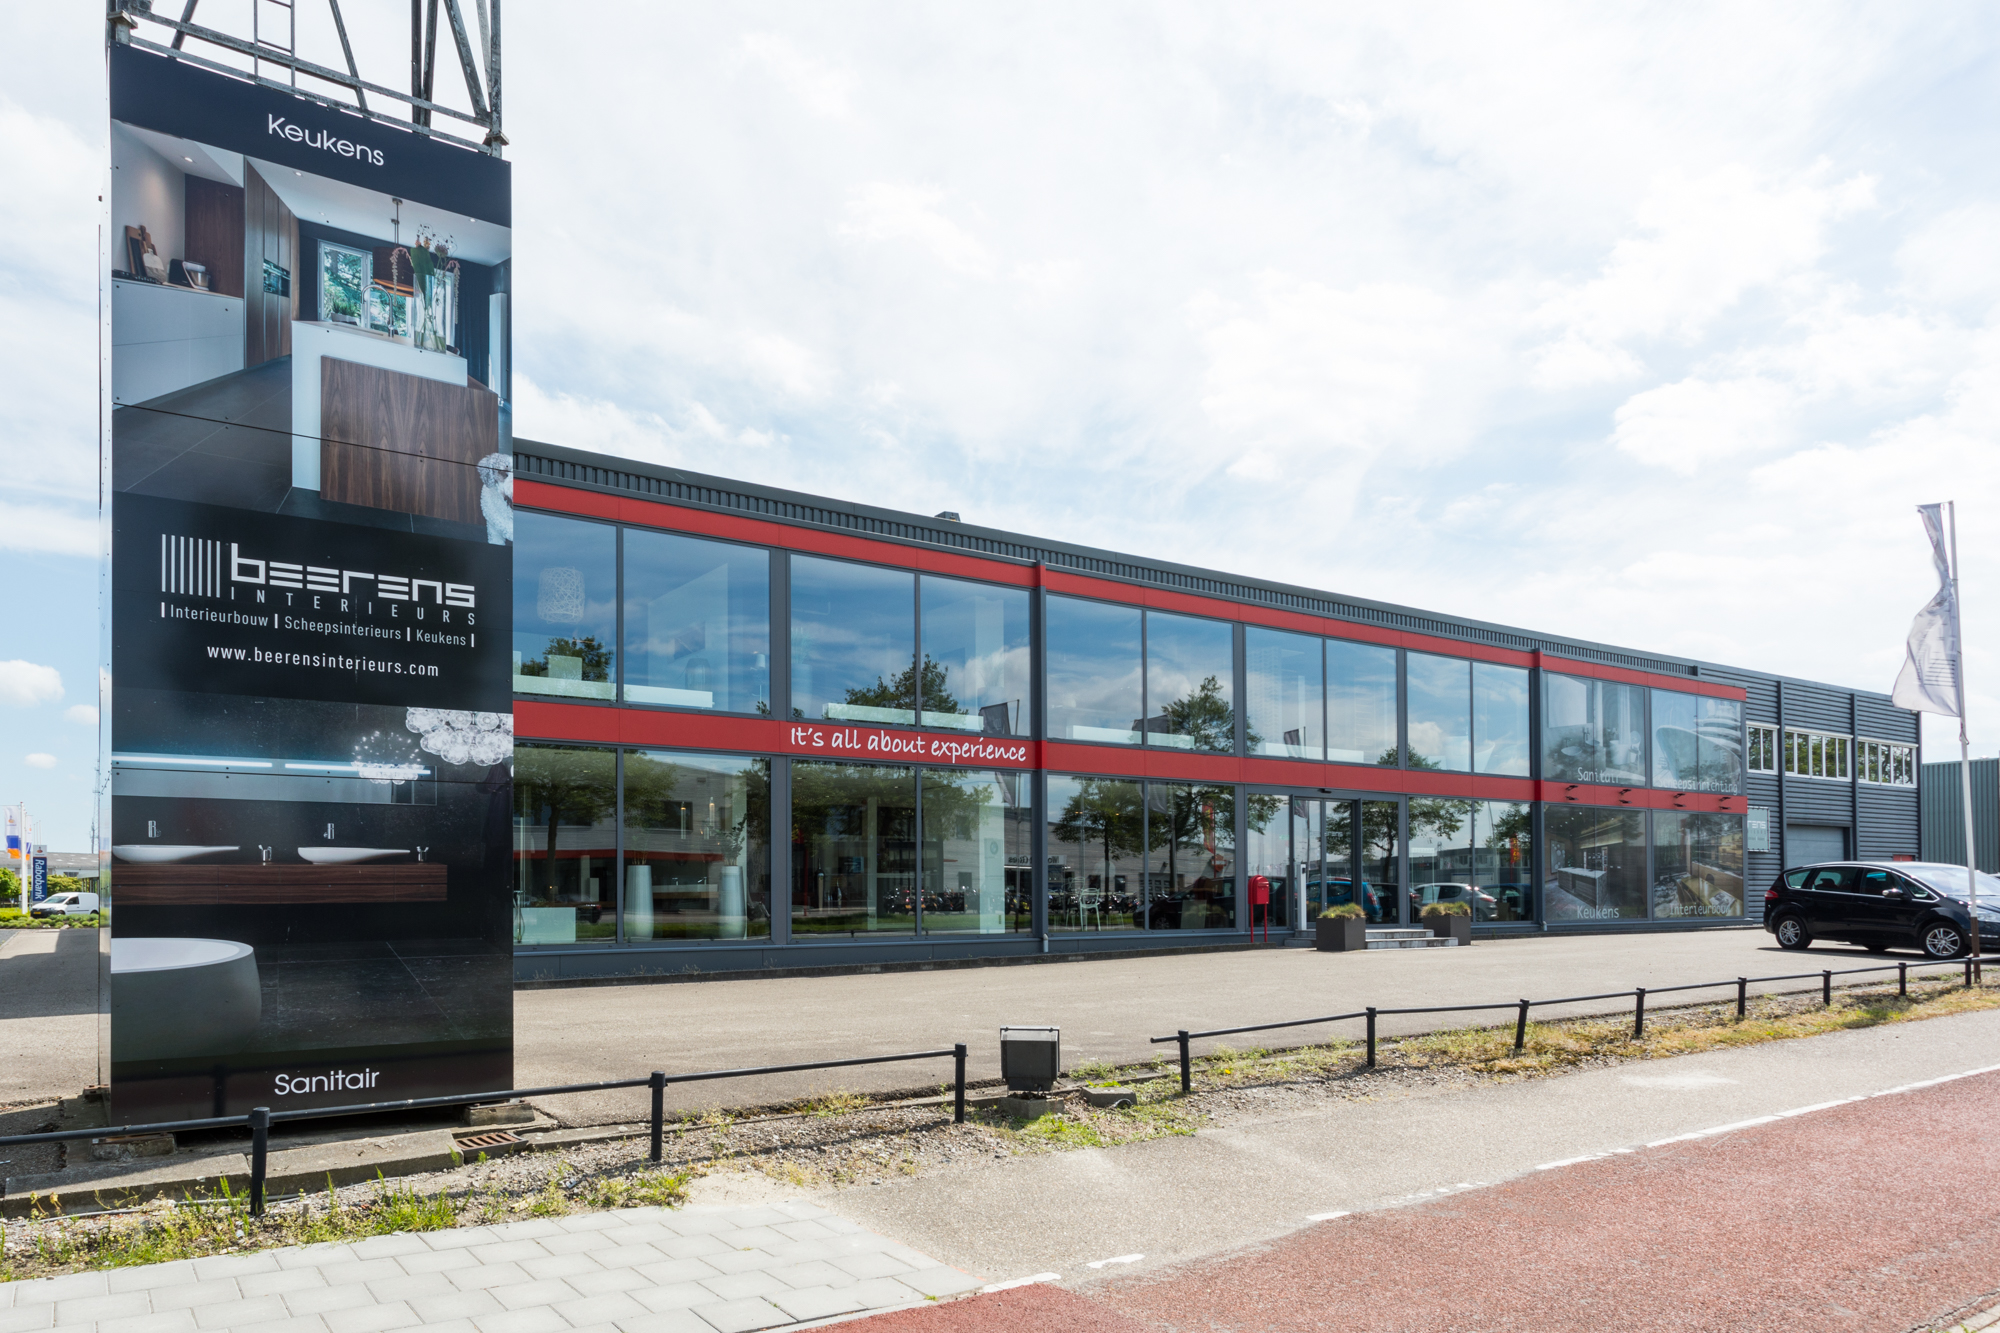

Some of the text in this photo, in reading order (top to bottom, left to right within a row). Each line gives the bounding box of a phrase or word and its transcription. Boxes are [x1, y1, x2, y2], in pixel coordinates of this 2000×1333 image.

[268, 113, 385, 166] Keukens
[230, 542, 475, 608] beerens
[170, 604, 467, 646] Interieurbouw Scheepsinterieurs Keukens
[231, 586, 475, 626] INTERIEURS
[206, 646, 440, 677] www.beerensinterieurs.com
[791, 726, 1027, 764] It's all about experience
[1577, 766, 1620, 784] Sanitair
[34, 859, 45, 899] Rabobank
[1577, 905, 1620, 920] Keukens
[274, 1067, 380, 1096] Sanitair
